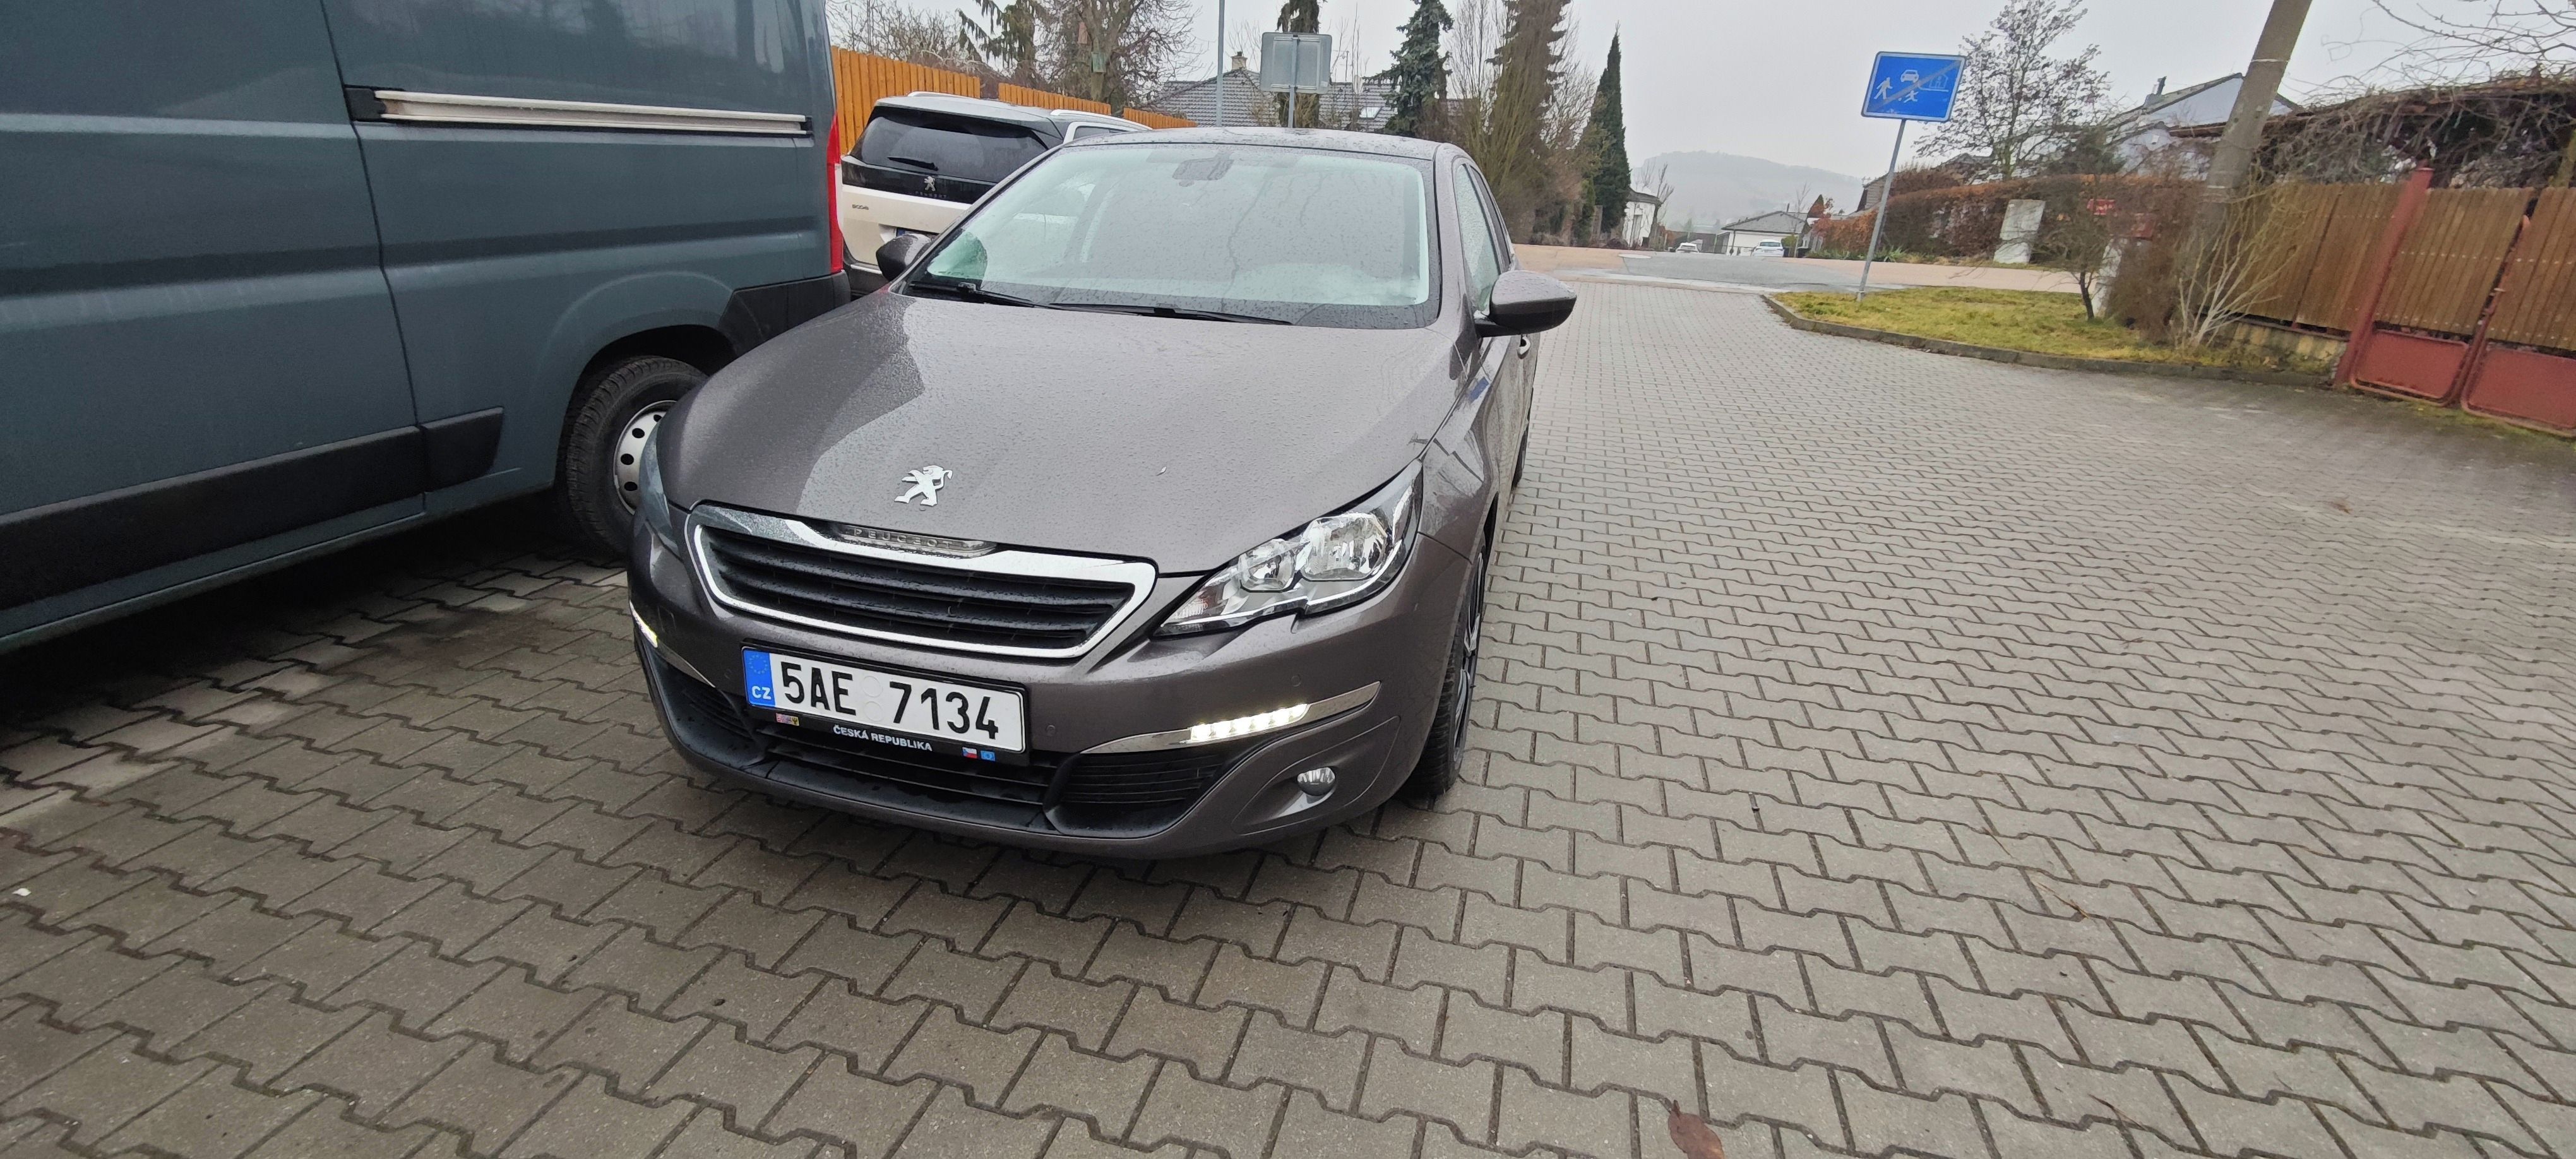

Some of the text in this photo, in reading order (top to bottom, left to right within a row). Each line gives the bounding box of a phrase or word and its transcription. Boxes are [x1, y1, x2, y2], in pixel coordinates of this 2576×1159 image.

[854, 528, 952, 548] PEUGEOT
[752, 686, 772, 699] CZ
[780, 661, 999, 739] 5AE 7134
[833, 724, 933, 751] ČESKÁ REPUBLIKA
